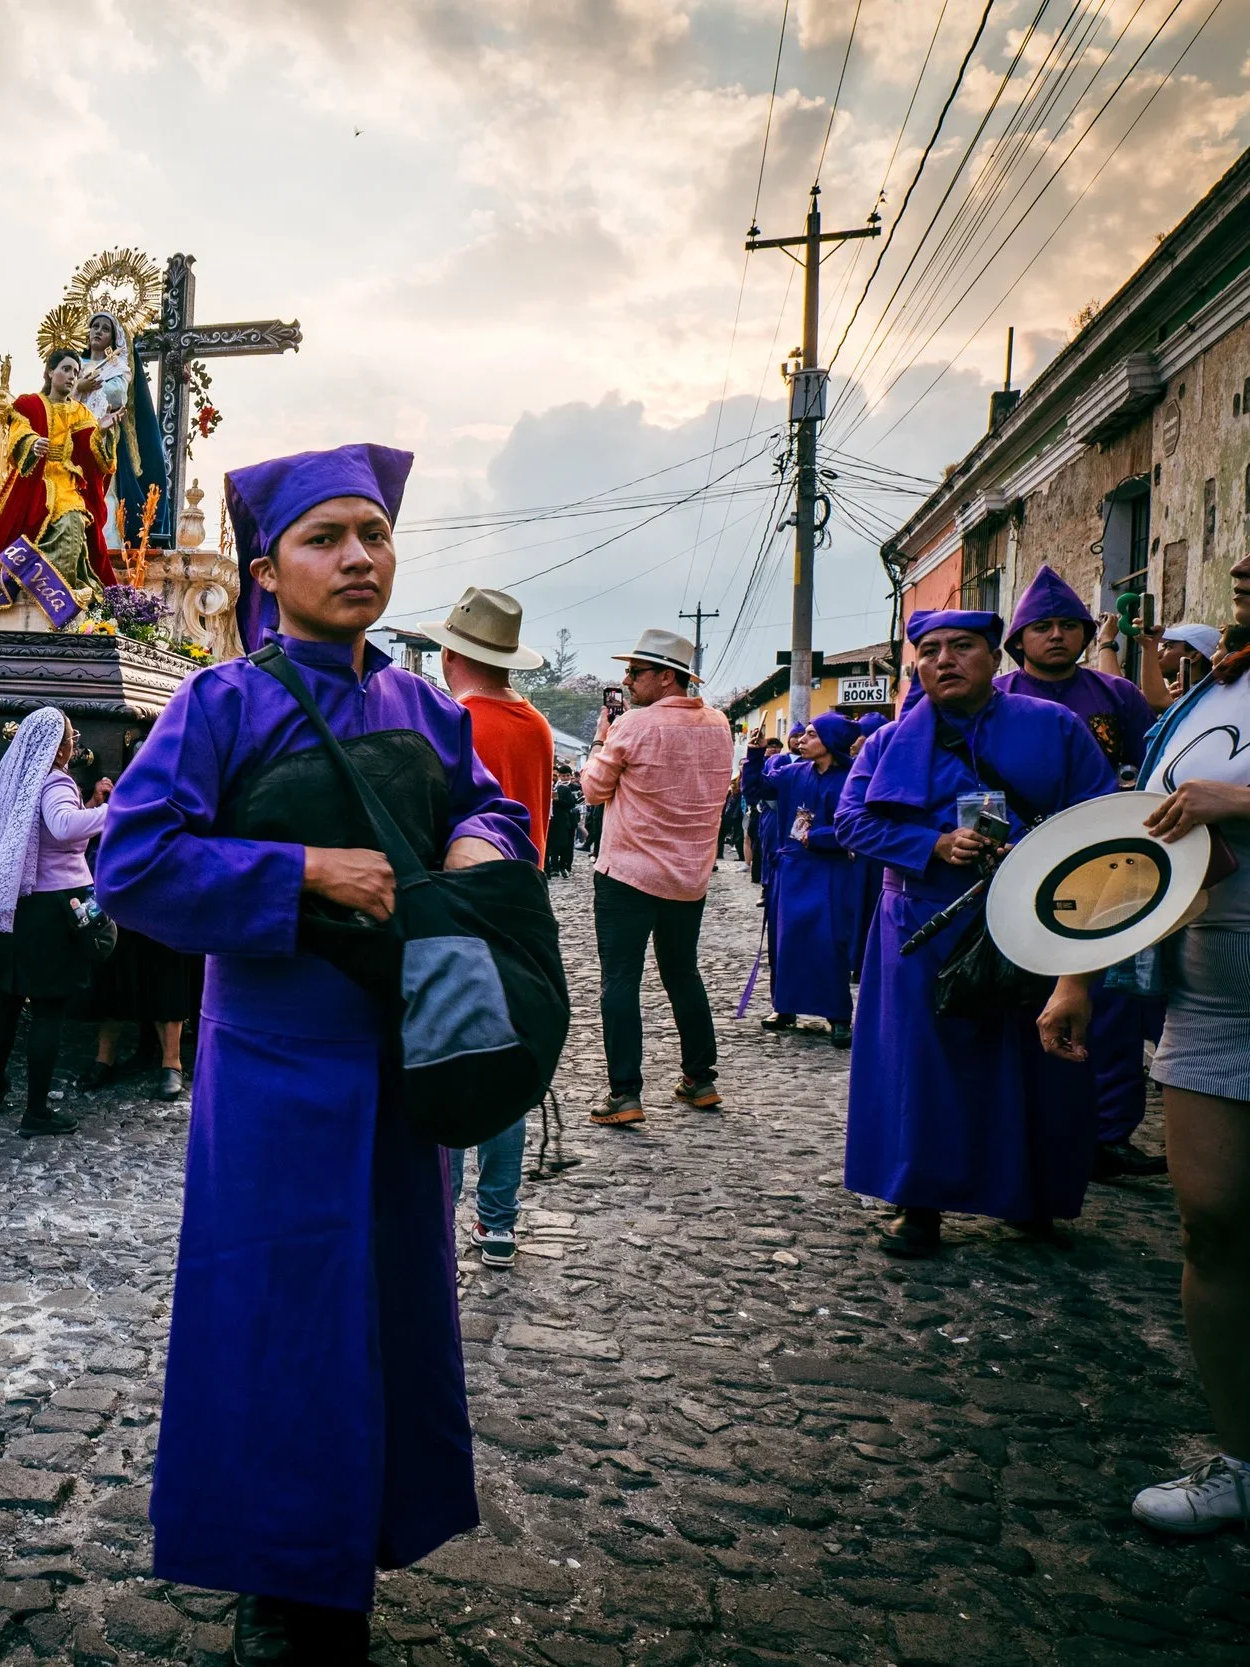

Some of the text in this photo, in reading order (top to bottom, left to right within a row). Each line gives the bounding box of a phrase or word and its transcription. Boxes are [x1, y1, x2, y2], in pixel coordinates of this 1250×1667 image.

[4, 546, 66, 613] de Vida
[844, 689, 883, 701] BOOKS
